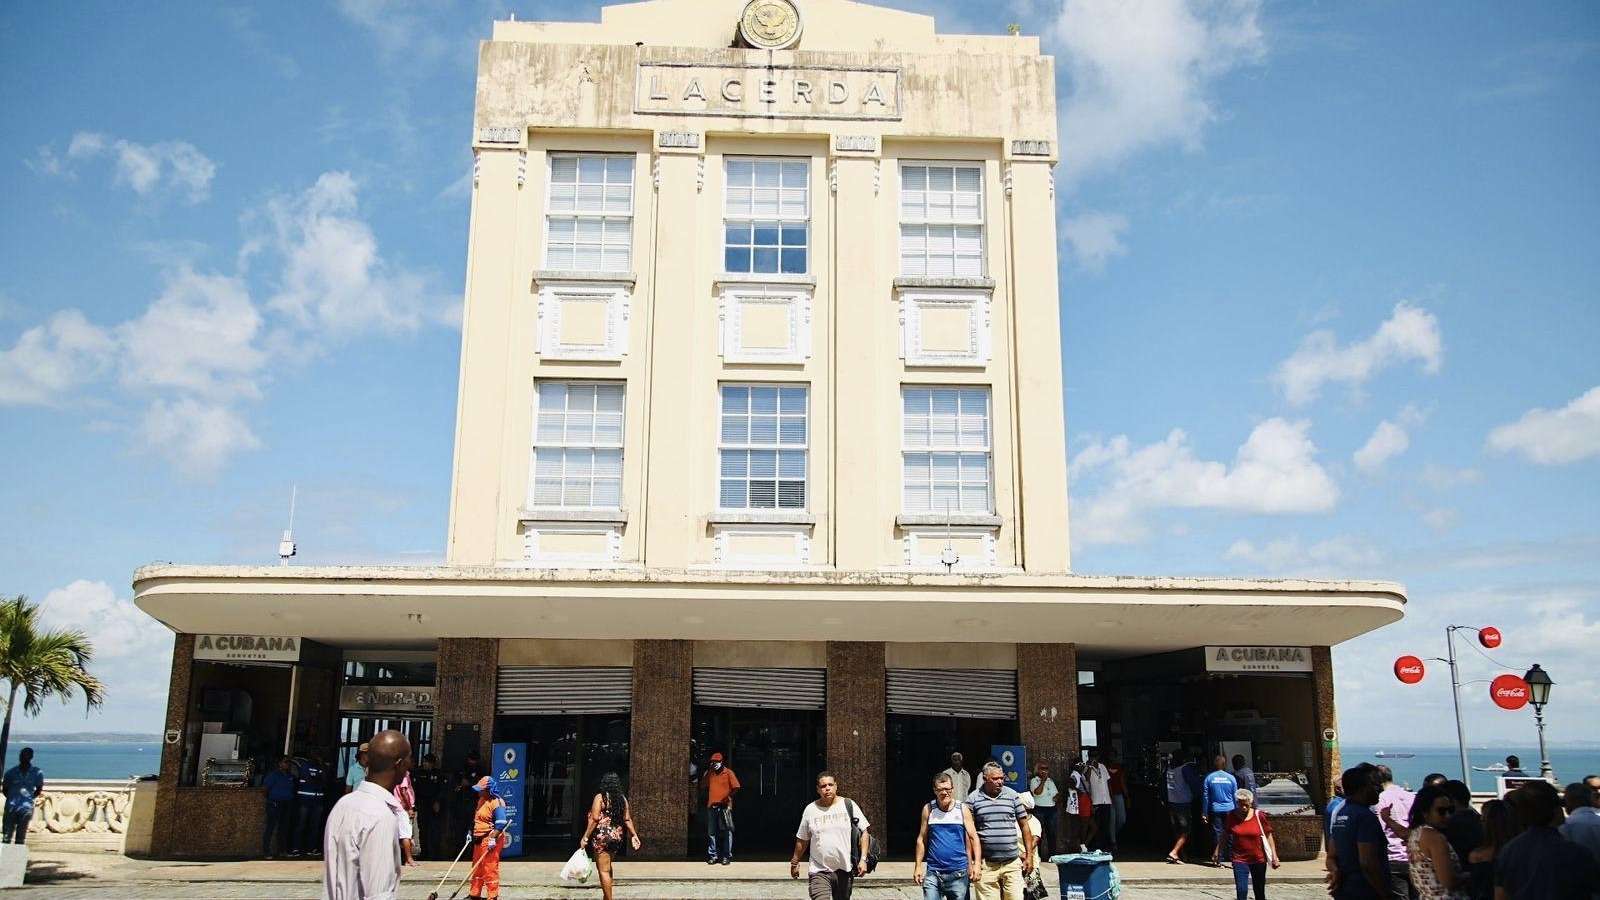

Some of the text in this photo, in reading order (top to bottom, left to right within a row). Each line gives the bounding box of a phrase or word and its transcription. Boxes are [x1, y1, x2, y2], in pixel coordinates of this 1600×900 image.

[650, 76, 886, 106] LACERDA
[199, 635, 296, 651] A CUBANA
[1216, 648, 1305, 662] A CUBANA
[355, 691, 433, 705] ENTRAD
[1496, 687, 1525, 698] Coca-Cola
